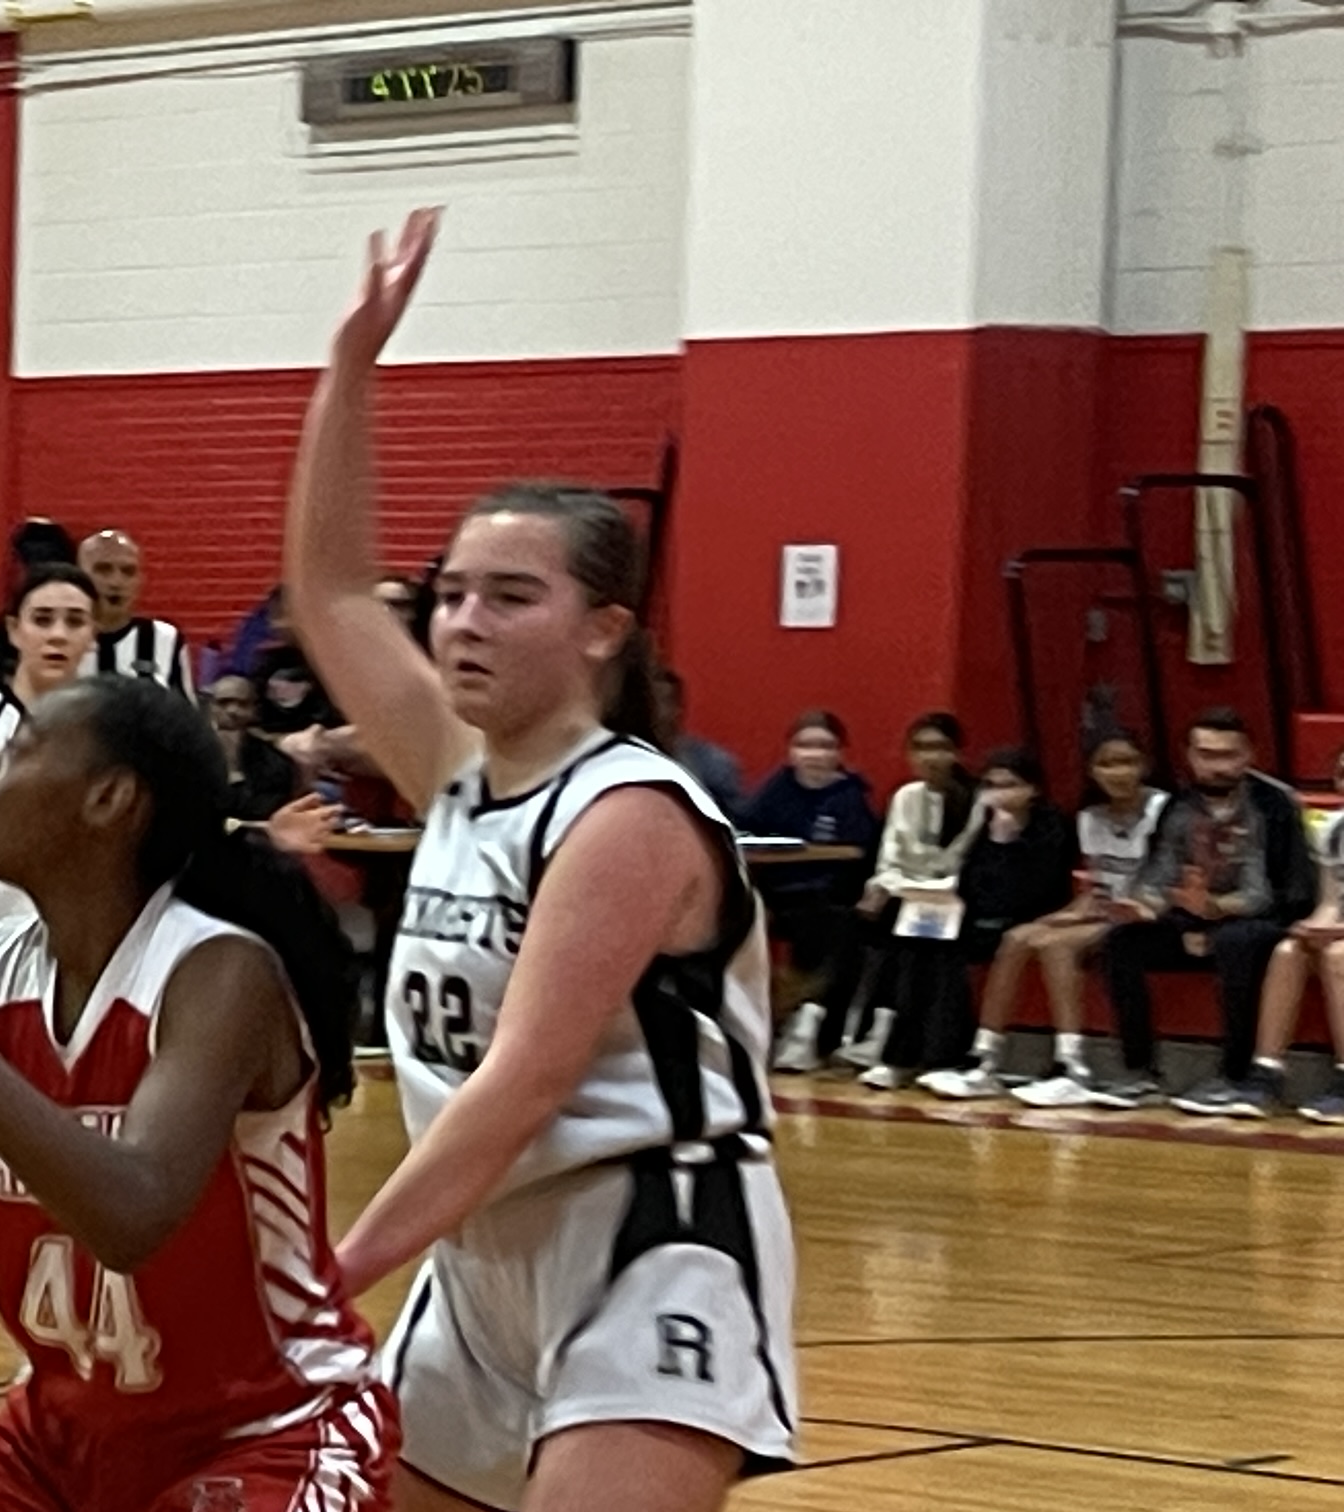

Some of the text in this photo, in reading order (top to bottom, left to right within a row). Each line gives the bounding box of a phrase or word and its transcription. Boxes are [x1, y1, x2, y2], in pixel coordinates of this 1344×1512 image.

[404, 970, 478, 1072] 22
[20, 1234, 163, 1393] 44
[655, 1313, 714, 1383] R
